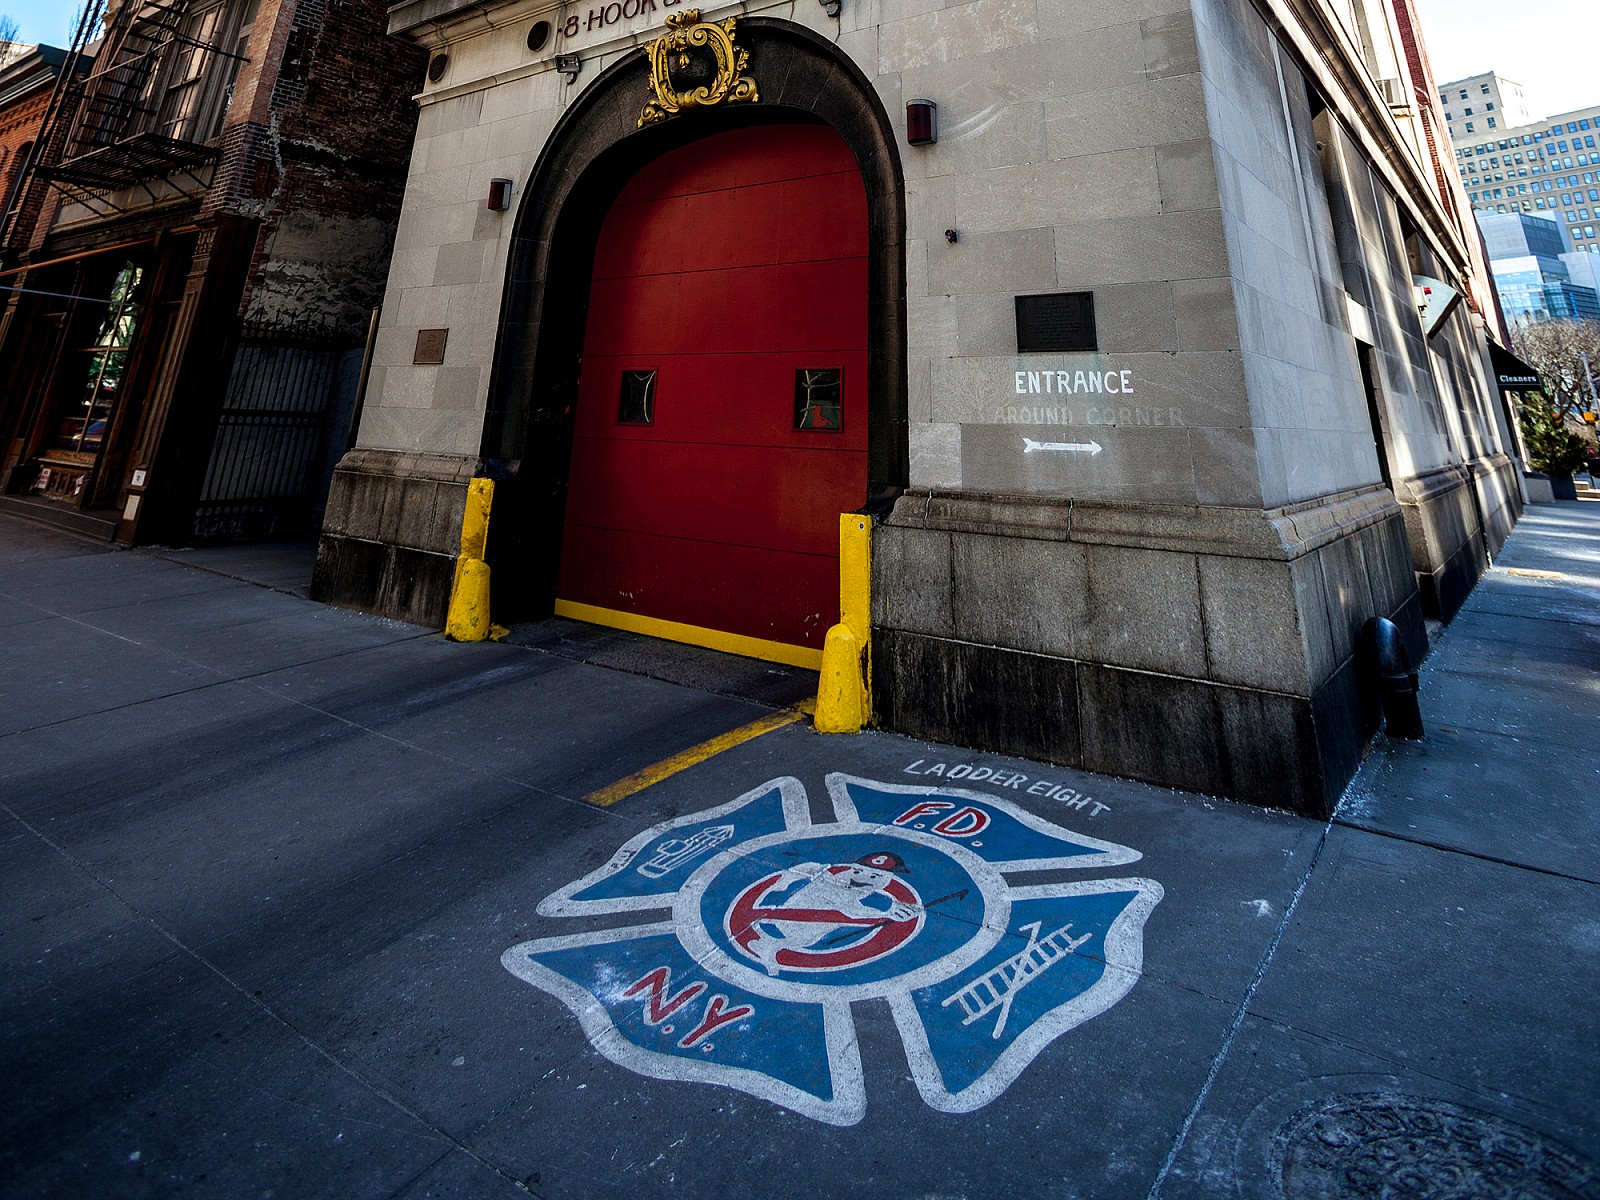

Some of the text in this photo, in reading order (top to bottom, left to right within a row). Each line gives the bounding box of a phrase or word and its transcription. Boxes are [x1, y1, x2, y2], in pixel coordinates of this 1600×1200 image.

[1014, 369, 1135, 395] ENTRANCE
[1499, 374, 1537, 383] Cleaners
[993, 406, 1186, 426] AROUND CORNER
[903, 759, 1111, 818] LADDER EIGHT
[892, 801, 992, 848] F.D.
[871, 855, 888, 865] 8
[621, 966, 756, 1052] N.Y.
